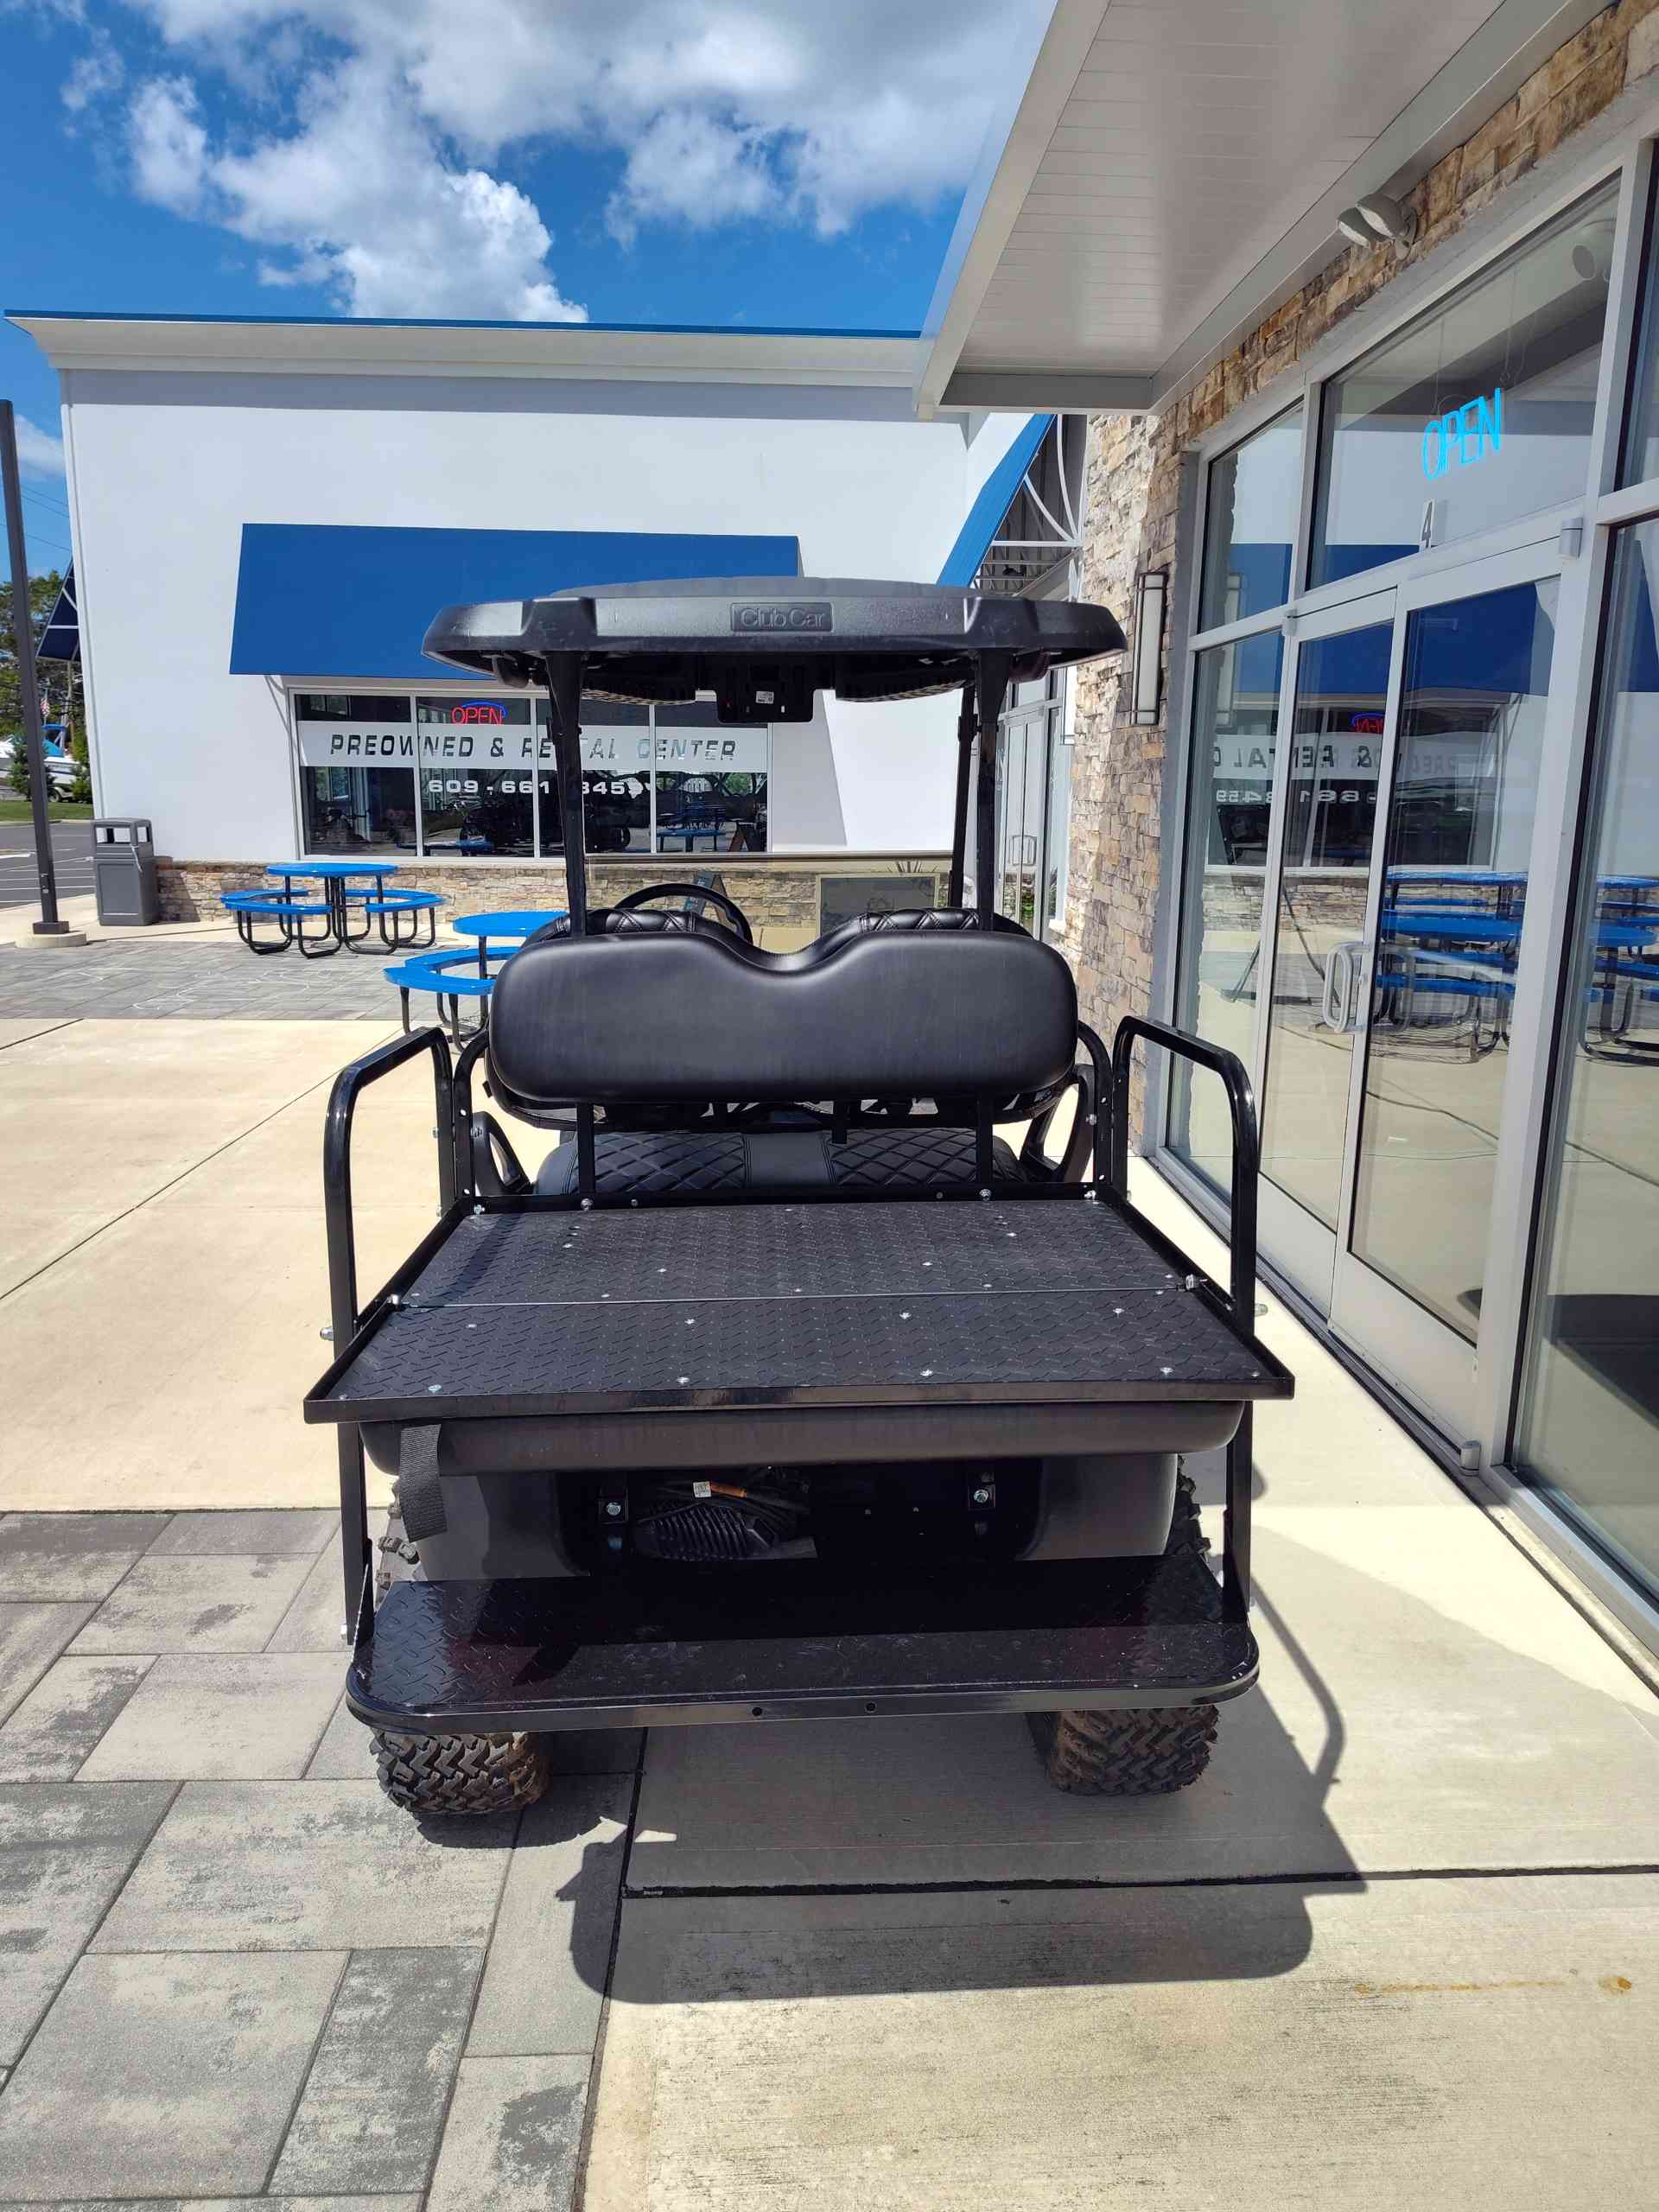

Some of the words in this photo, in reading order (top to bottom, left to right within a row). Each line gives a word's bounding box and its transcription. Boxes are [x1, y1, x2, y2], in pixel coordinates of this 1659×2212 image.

[1423, 387, 1502, 481] OPEN
[740, 608, 785, 627] Club
[790, 608, 824, 627] Car
[451, 707, 503, 725] OPEN
[330, 734, 474, 757] PREOWNED
[490, 737, 504, 758] &
[521, 738, 616, 759] REAL
[636, 739, 736, 760] CENTER
